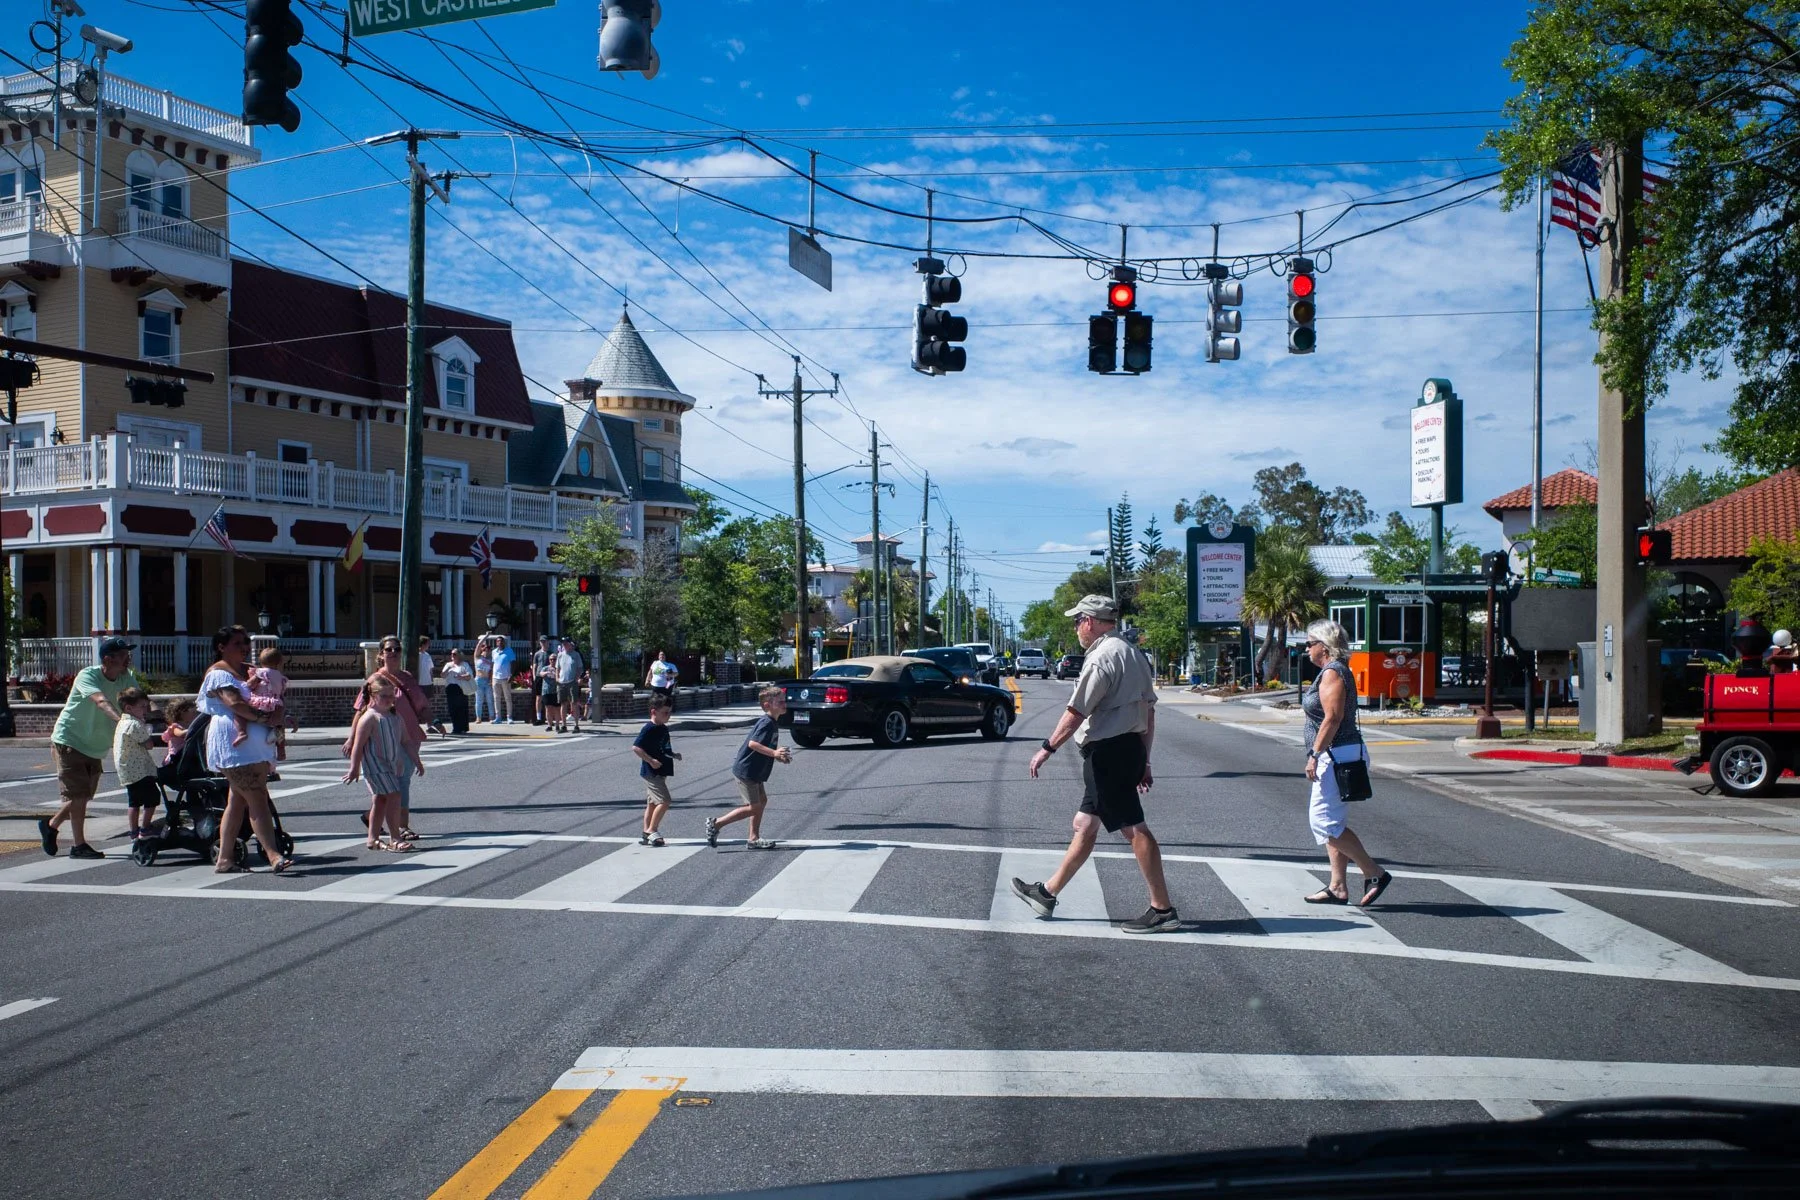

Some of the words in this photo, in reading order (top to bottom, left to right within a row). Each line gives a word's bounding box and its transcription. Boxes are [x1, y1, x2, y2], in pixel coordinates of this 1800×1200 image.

[354, 0, 411, 26] WEST
[1414, 419, 1430, 431] WELCOME
[1430, 418, 1442, 426] CENTER
[1427, 435, 1436, 443] MAPS
[1418, 456, 1440, 465] ATTRACTIONS
[1418, 468, 1434, 476] DISCOUNT
[1201, 553, 1224, 562] WELCOME
[1224, 553, 1242, 561] CENTER
[283, 662, 358, 672] RENAISSANCE
[1724, 686, 1759, 695] PONCE
